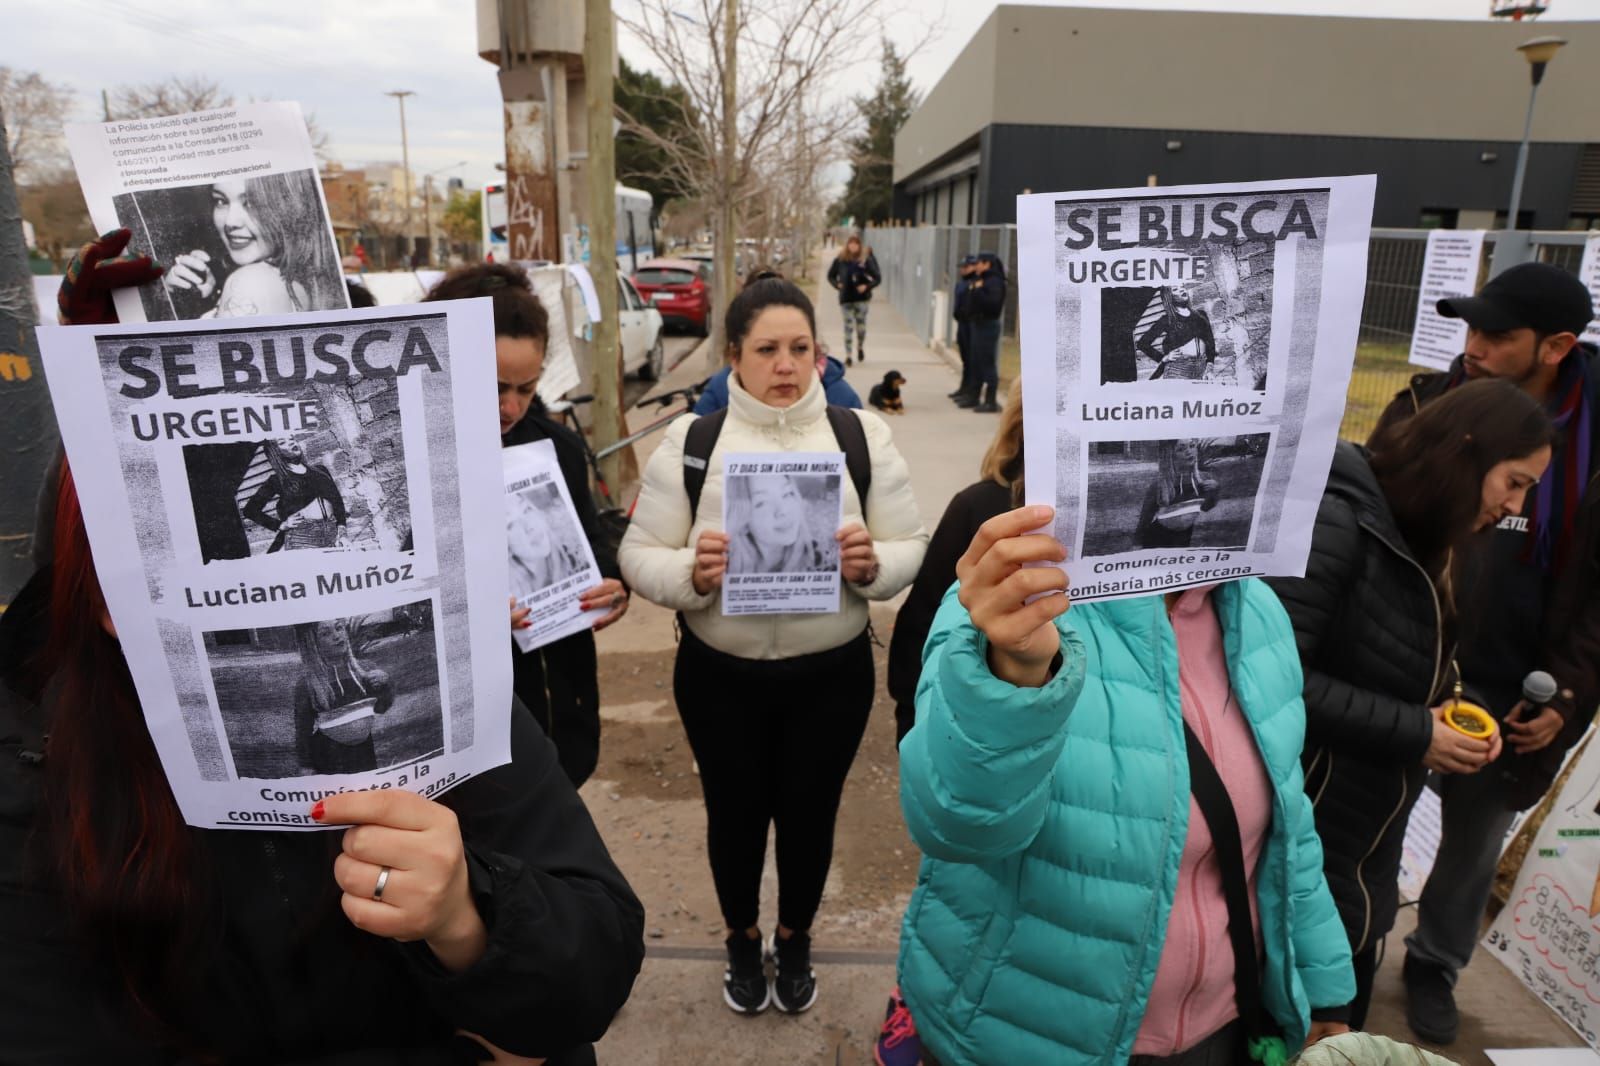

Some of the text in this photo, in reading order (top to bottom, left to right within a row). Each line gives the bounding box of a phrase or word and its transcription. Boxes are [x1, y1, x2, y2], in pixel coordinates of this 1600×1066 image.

[105, 126, 117, 134] La
[183, 116, 198, 127] que
[199, 111, 237, 122] cualquier
[164, 130, 187, 140] sobre
[201, 121, 237, 135] paradero
[113, 143, 167, 157] comunicada
[168, 150, 196, 163] unidad
[217, 144, 251, 155] cercana
[1064, 199, 1318, 250] SE BUSCA
[1068, 256, 1207, 284] URGENTE
[118, 326, 442, 400] SE BUSCA
[131, 401, 321, 441] URGENTE
[1082, 398, 1262, 421] Luciana Muñoz
[774, 463, 808, 473] LUCIANA
[1093, 551, 1230, 574] Comunícate a la
[185, 563, 414, 608] Luciana Muñoz
[1149, 570, 1182, 588] más
[1187, 565, 1252, 581] cercana
[398, 774, 408, 787] a
[414, 764, 430, 780] la
